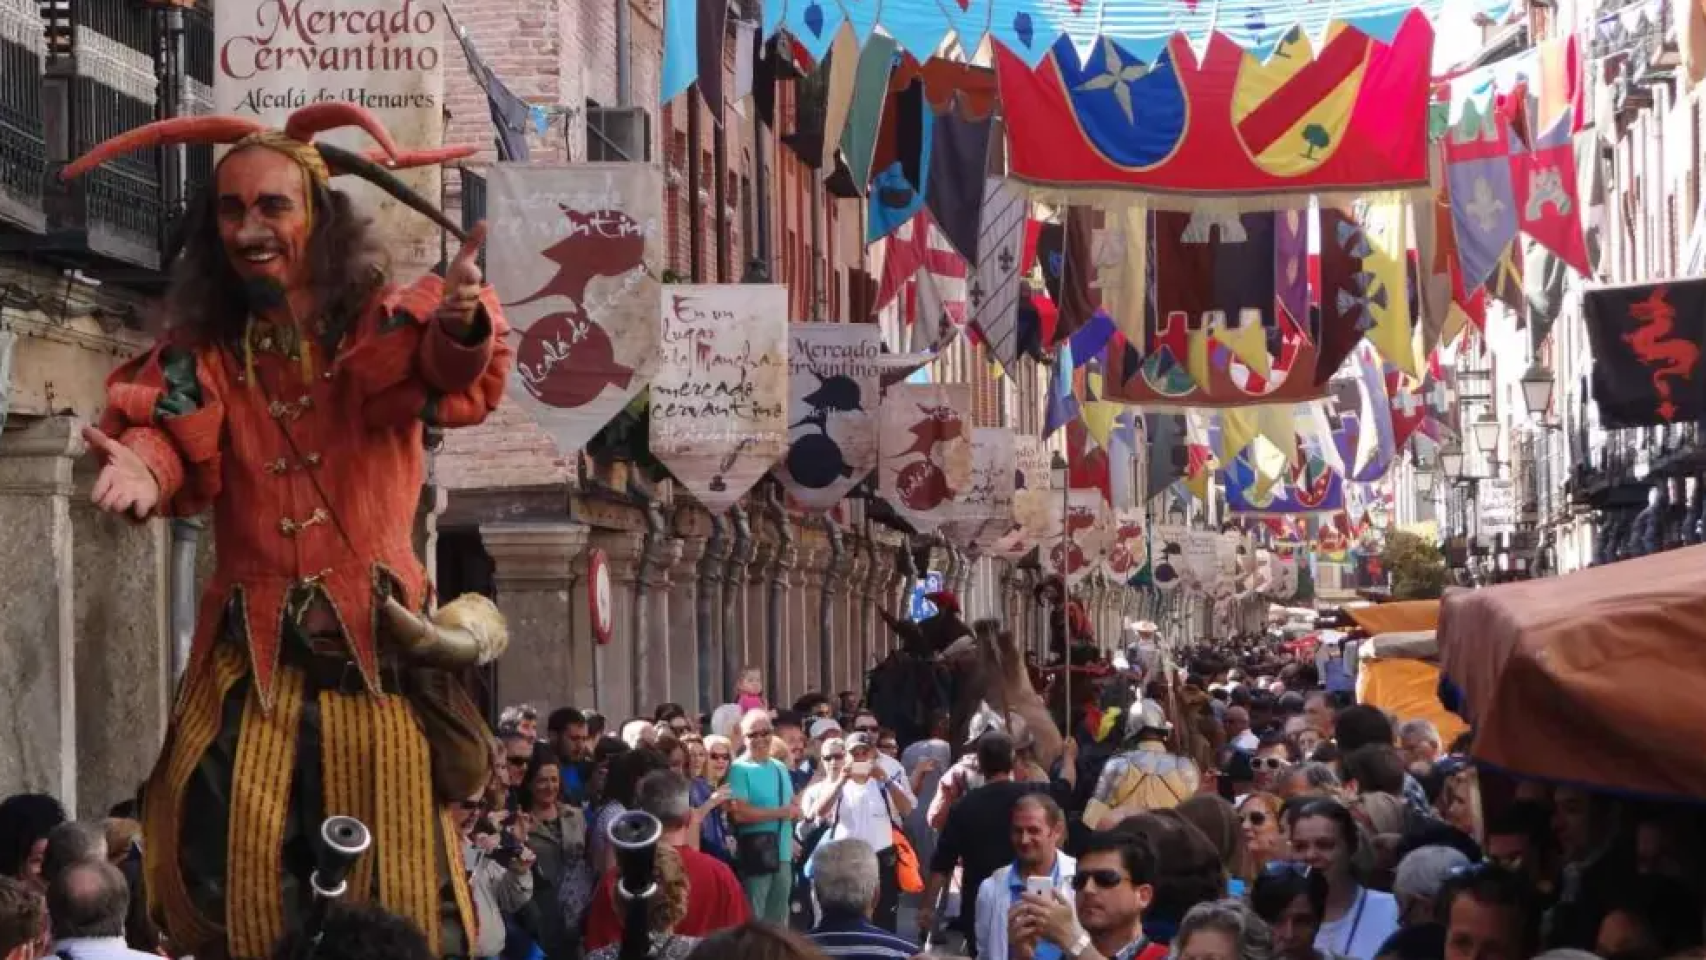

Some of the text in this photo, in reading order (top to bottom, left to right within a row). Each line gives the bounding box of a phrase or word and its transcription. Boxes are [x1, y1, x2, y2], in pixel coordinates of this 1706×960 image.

[256, 0, 435, 45] Mercado
[220, 36, 438, 79] Cervantino
[235, 87, 306, 113] Alcalá
[341, 88, 435, 109] Henares
[788, 337, 879, 361] Mercado
